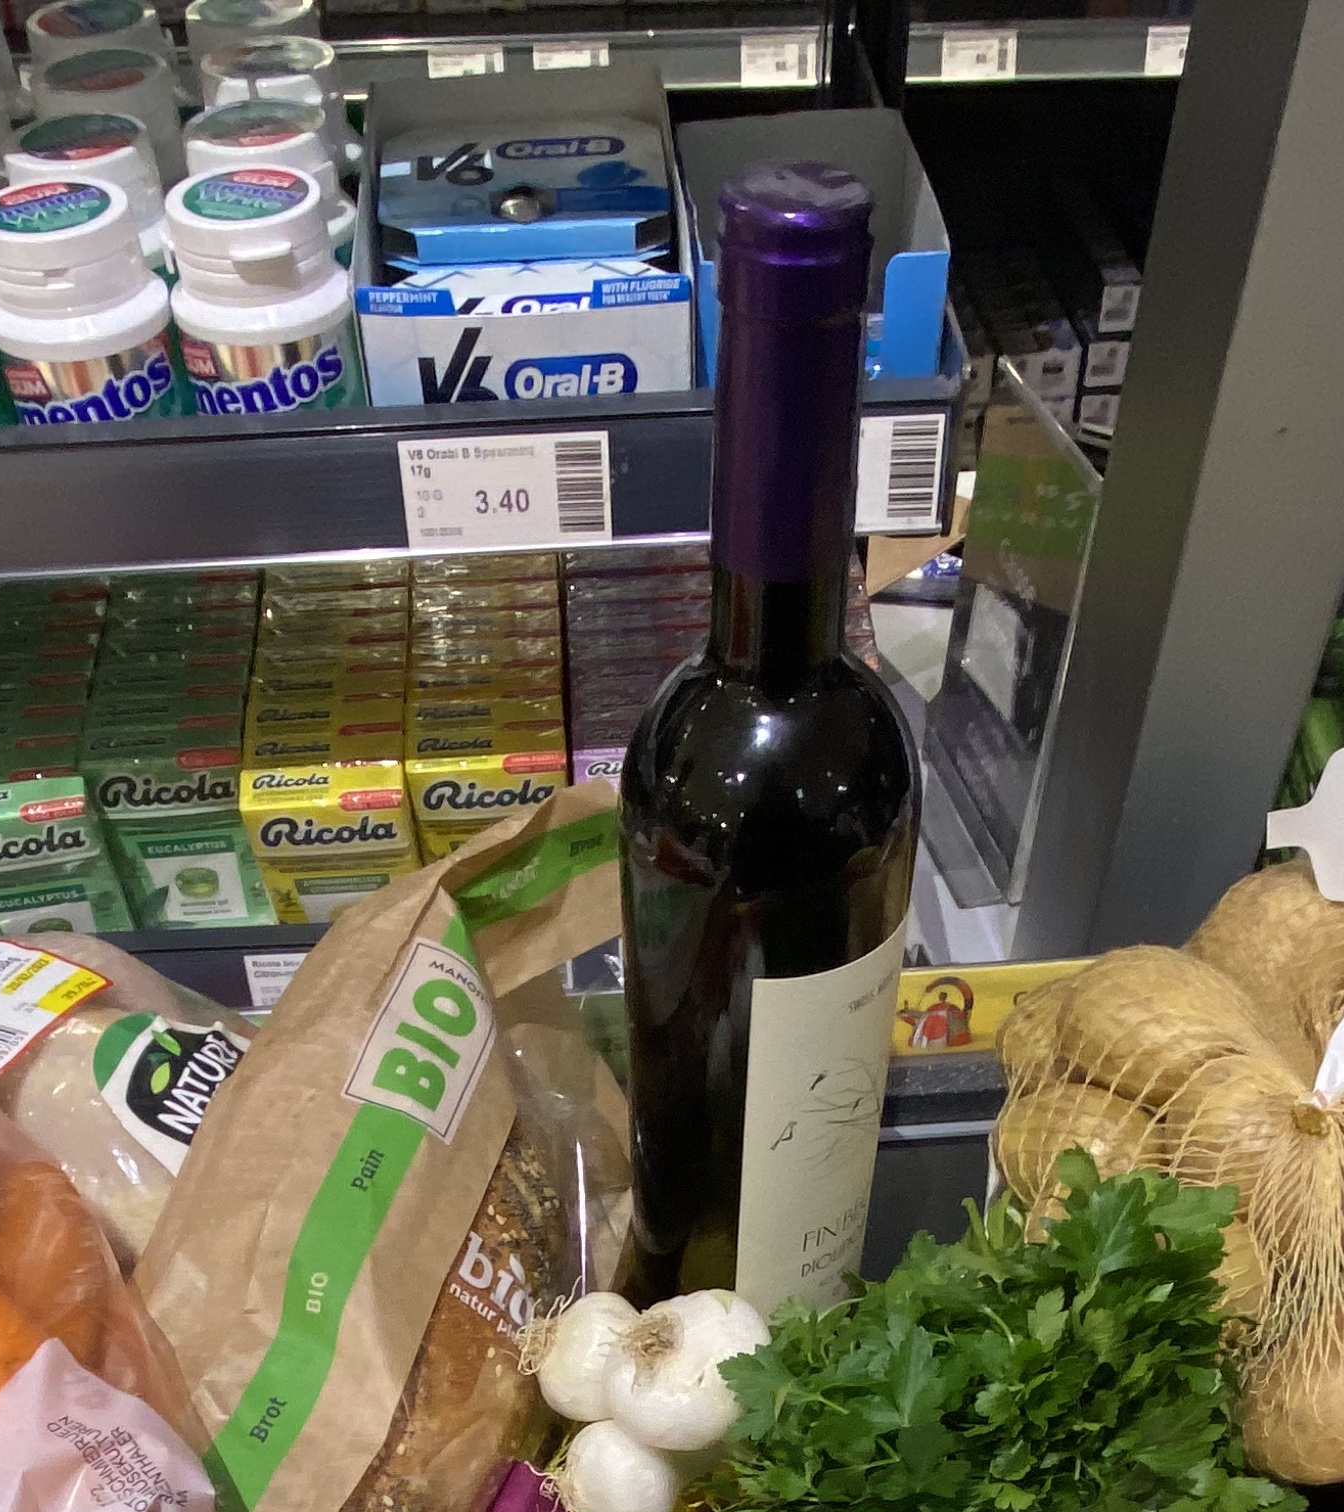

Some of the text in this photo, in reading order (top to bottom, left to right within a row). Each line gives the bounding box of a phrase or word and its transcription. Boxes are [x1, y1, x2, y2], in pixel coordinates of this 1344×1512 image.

[505, 136, 622, 159] Oral-B
[368, 291, 439, 304] PEPPERMINT
[513, 363, 625, 399] Oral-B
[475, 488, 531, 515] 3.40
[98, 774, 236, 808] Ricola
[252, 773, 330, 790] Ricola
[146, 839, 229, 855] EUCALYPTUS
[261, 816, 397, 848] Ricola
[371, 979, 478, 1113] BIO
[157, 1033, 240, 1136] NATURE
[352, 1147, 385, 1194] Pain
[305, 1271, 330, 1315] BIO
[448, 1281, 497, 1324] natur
[249, 1395, 287, 1444] Brot
